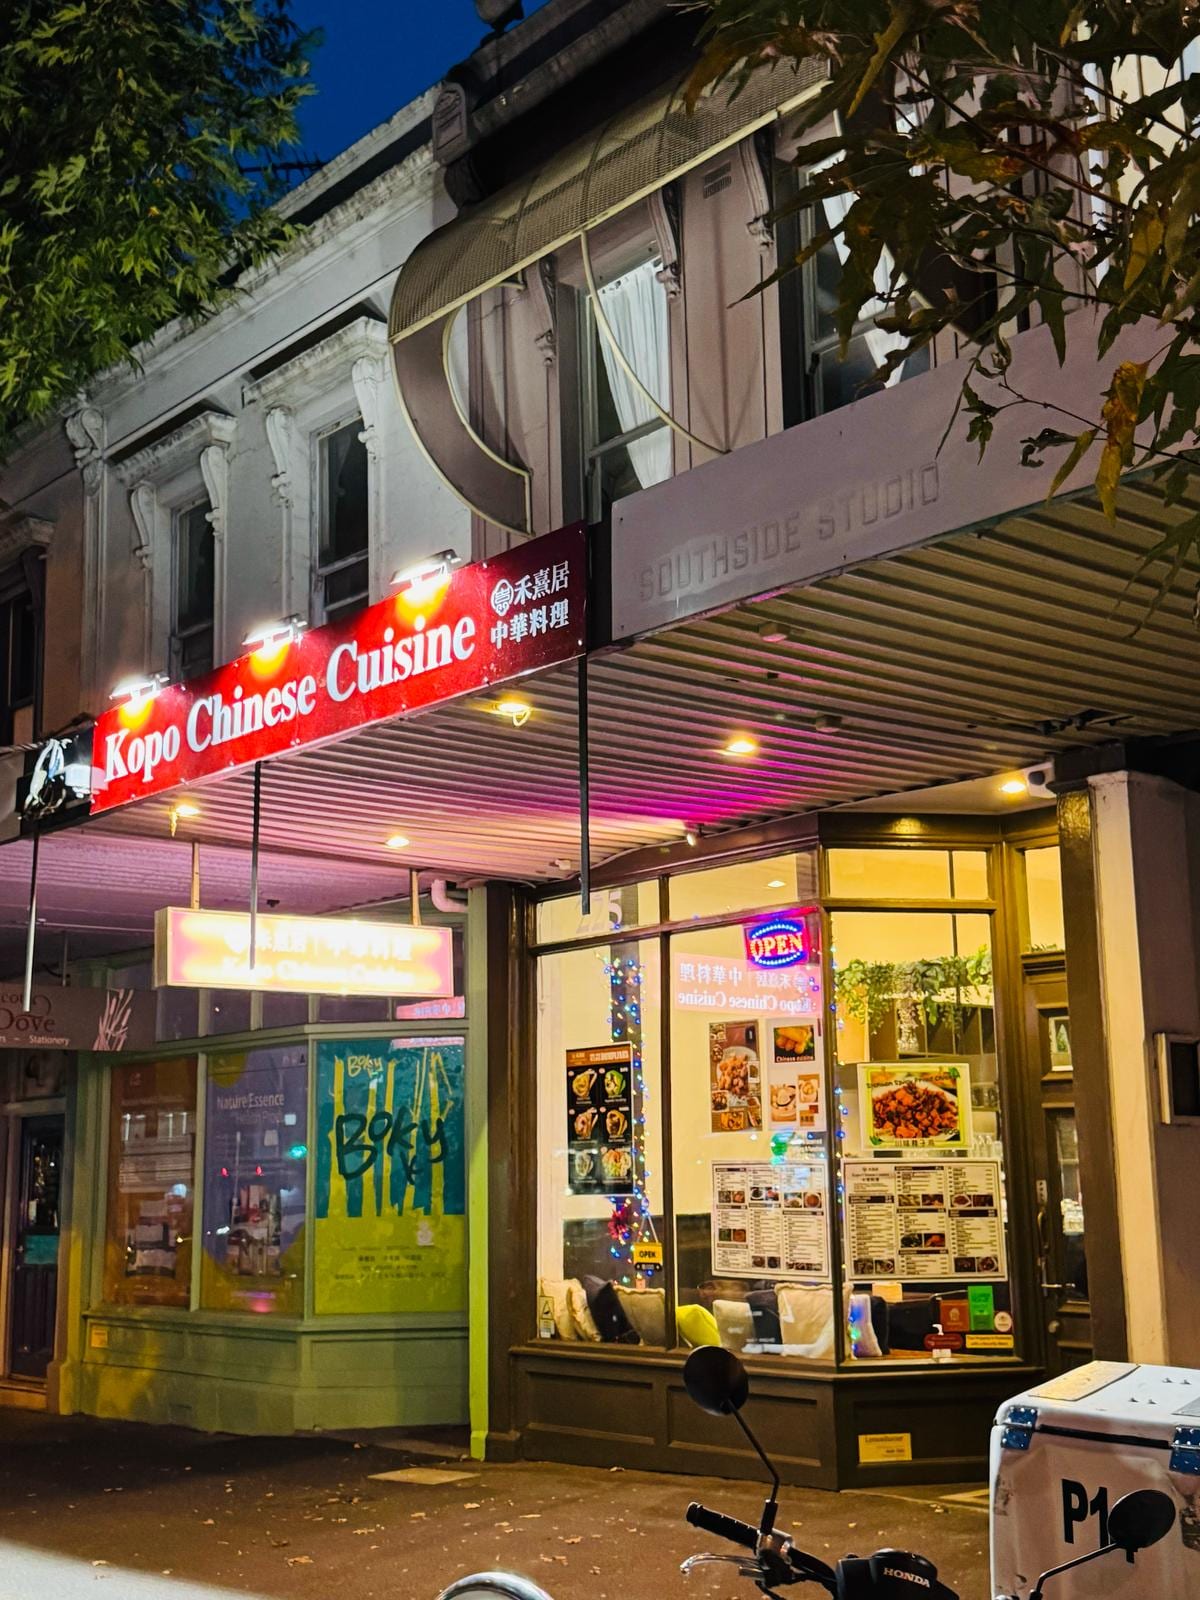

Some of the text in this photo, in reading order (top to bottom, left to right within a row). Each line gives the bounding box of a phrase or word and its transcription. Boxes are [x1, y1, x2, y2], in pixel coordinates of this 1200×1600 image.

[638, 461, 940, 599] SOUTHSIDE STUDIO
[490, 598, 570, 650] 中華料理
[104, 614, 476, 783] Kopo Chinese Cuisine
[749, 931, 803, 960] OPEN
[638, 1250, 657, 1259] OPEN
[882, 1566, 931, 1589] HONDA
